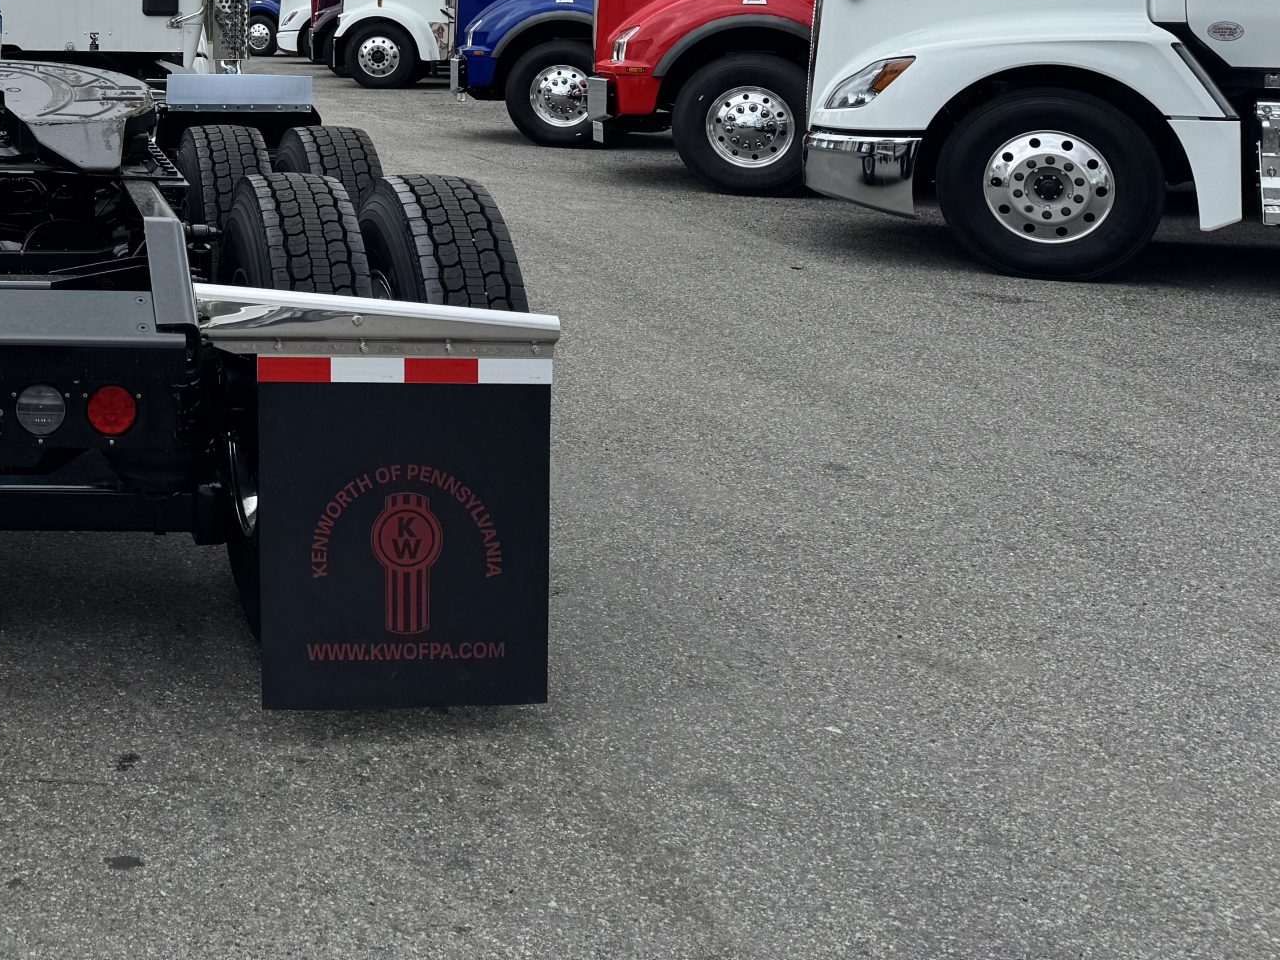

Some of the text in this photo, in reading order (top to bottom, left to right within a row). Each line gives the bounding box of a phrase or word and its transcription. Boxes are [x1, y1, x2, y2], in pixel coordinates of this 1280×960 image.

[311, 464, 503, 579] KENWORTH OF PENNSYLVANIA
[306, 641, 506, 661] WWW.KWOFPA.COM
